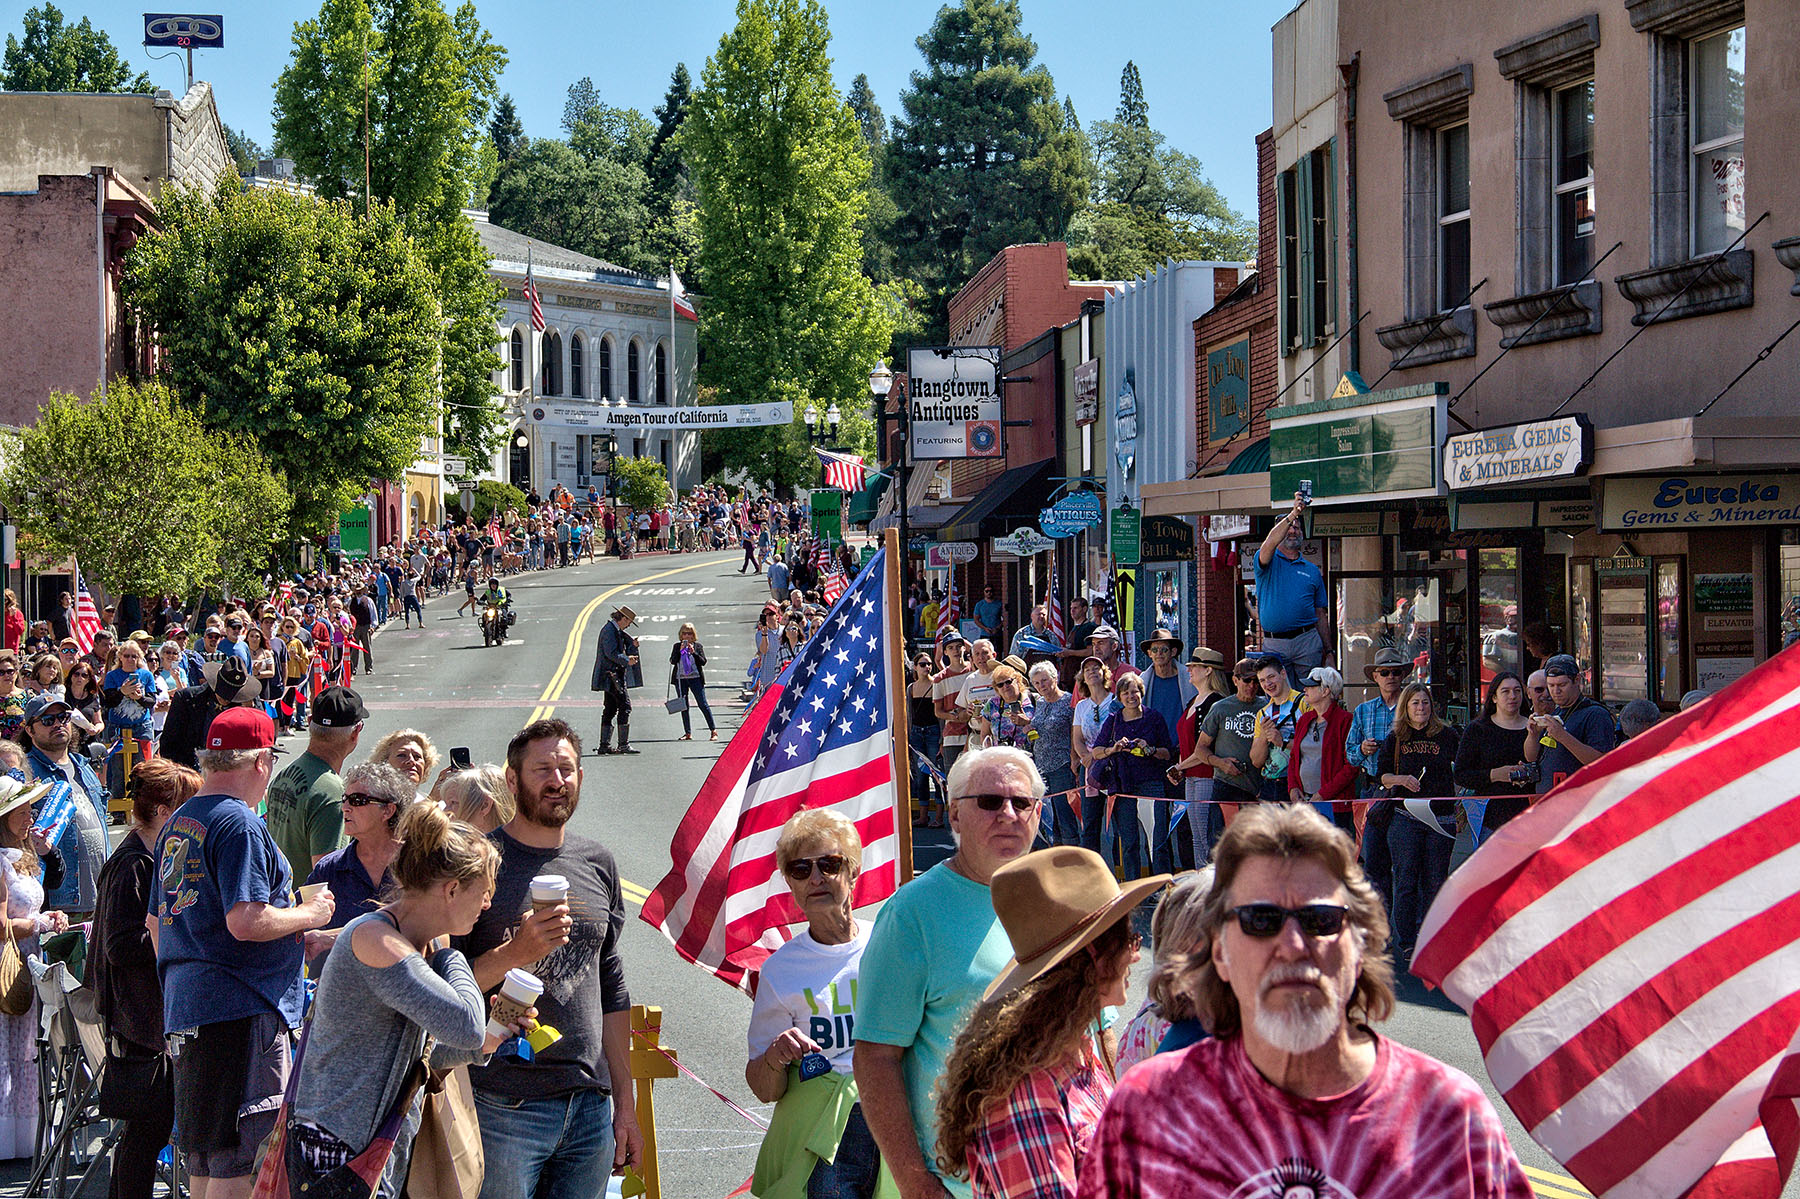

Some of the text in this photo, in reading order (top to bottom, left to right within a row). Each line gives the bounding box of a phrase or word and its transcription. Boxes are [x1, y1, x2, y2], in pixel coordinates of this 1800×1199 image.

[178, 37, 190, 45] 20
[911, 377, 990, 402] Hangtown
[606, 409, 728, 427] Amgen Tour of California
[912, 401, 979, 426] Antiques
[982, 420, 996, 431] SIDE
[916, 437, 963, 445] FEATURING
[1452, 424, 1572, 459] EUREKA GEMS
[970, 446, 997, 457] RECORDS
[1459, 452, 1564, 482] & MINERALS
[1653, 478, 1780, 509] Eureka
[812, 508, 840, 518] Sprint
[1044, 508, 1098, 524] ANTIQUES
[1562, 514, 1589, 522] SALON
[1622, 510, 1680, 527] Gems
[1683, 510, 1704, 523] &
[340, 519, 368, 530] Sprint
[1152, 521, 1188, 542] TOWN
[940, 546, 976, 556] ANTIQUES
[1142, 541, 1170, 557] GRILL
[624, 587, 716, 596] AHEAD
[633, 614, 687, 623] TOP
[1225, 721, 1255, 731] BIKE SH
[1401, 743, 1440, 755] GIANTS
